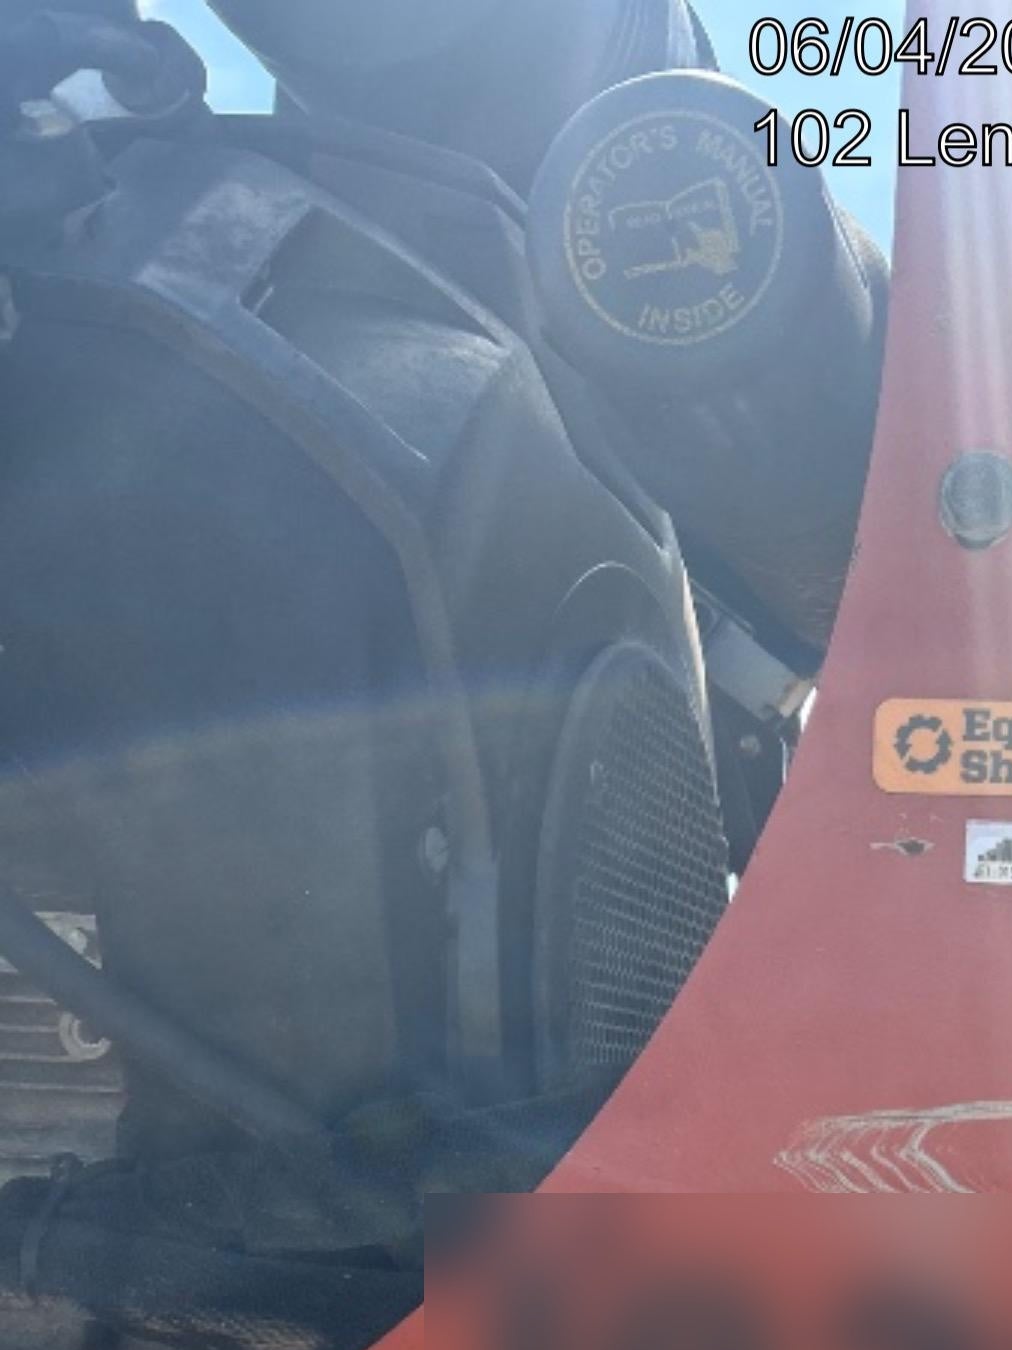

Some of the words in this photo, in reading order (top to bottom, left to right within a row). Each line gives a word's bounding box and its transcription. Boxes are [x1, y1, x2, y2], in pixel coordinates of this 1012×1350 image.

[576, 126, 678, 280] OPERATOR'S
[697, 128, 774, 236] MANUAL
[637, 282, 745, 333] INSIDE
